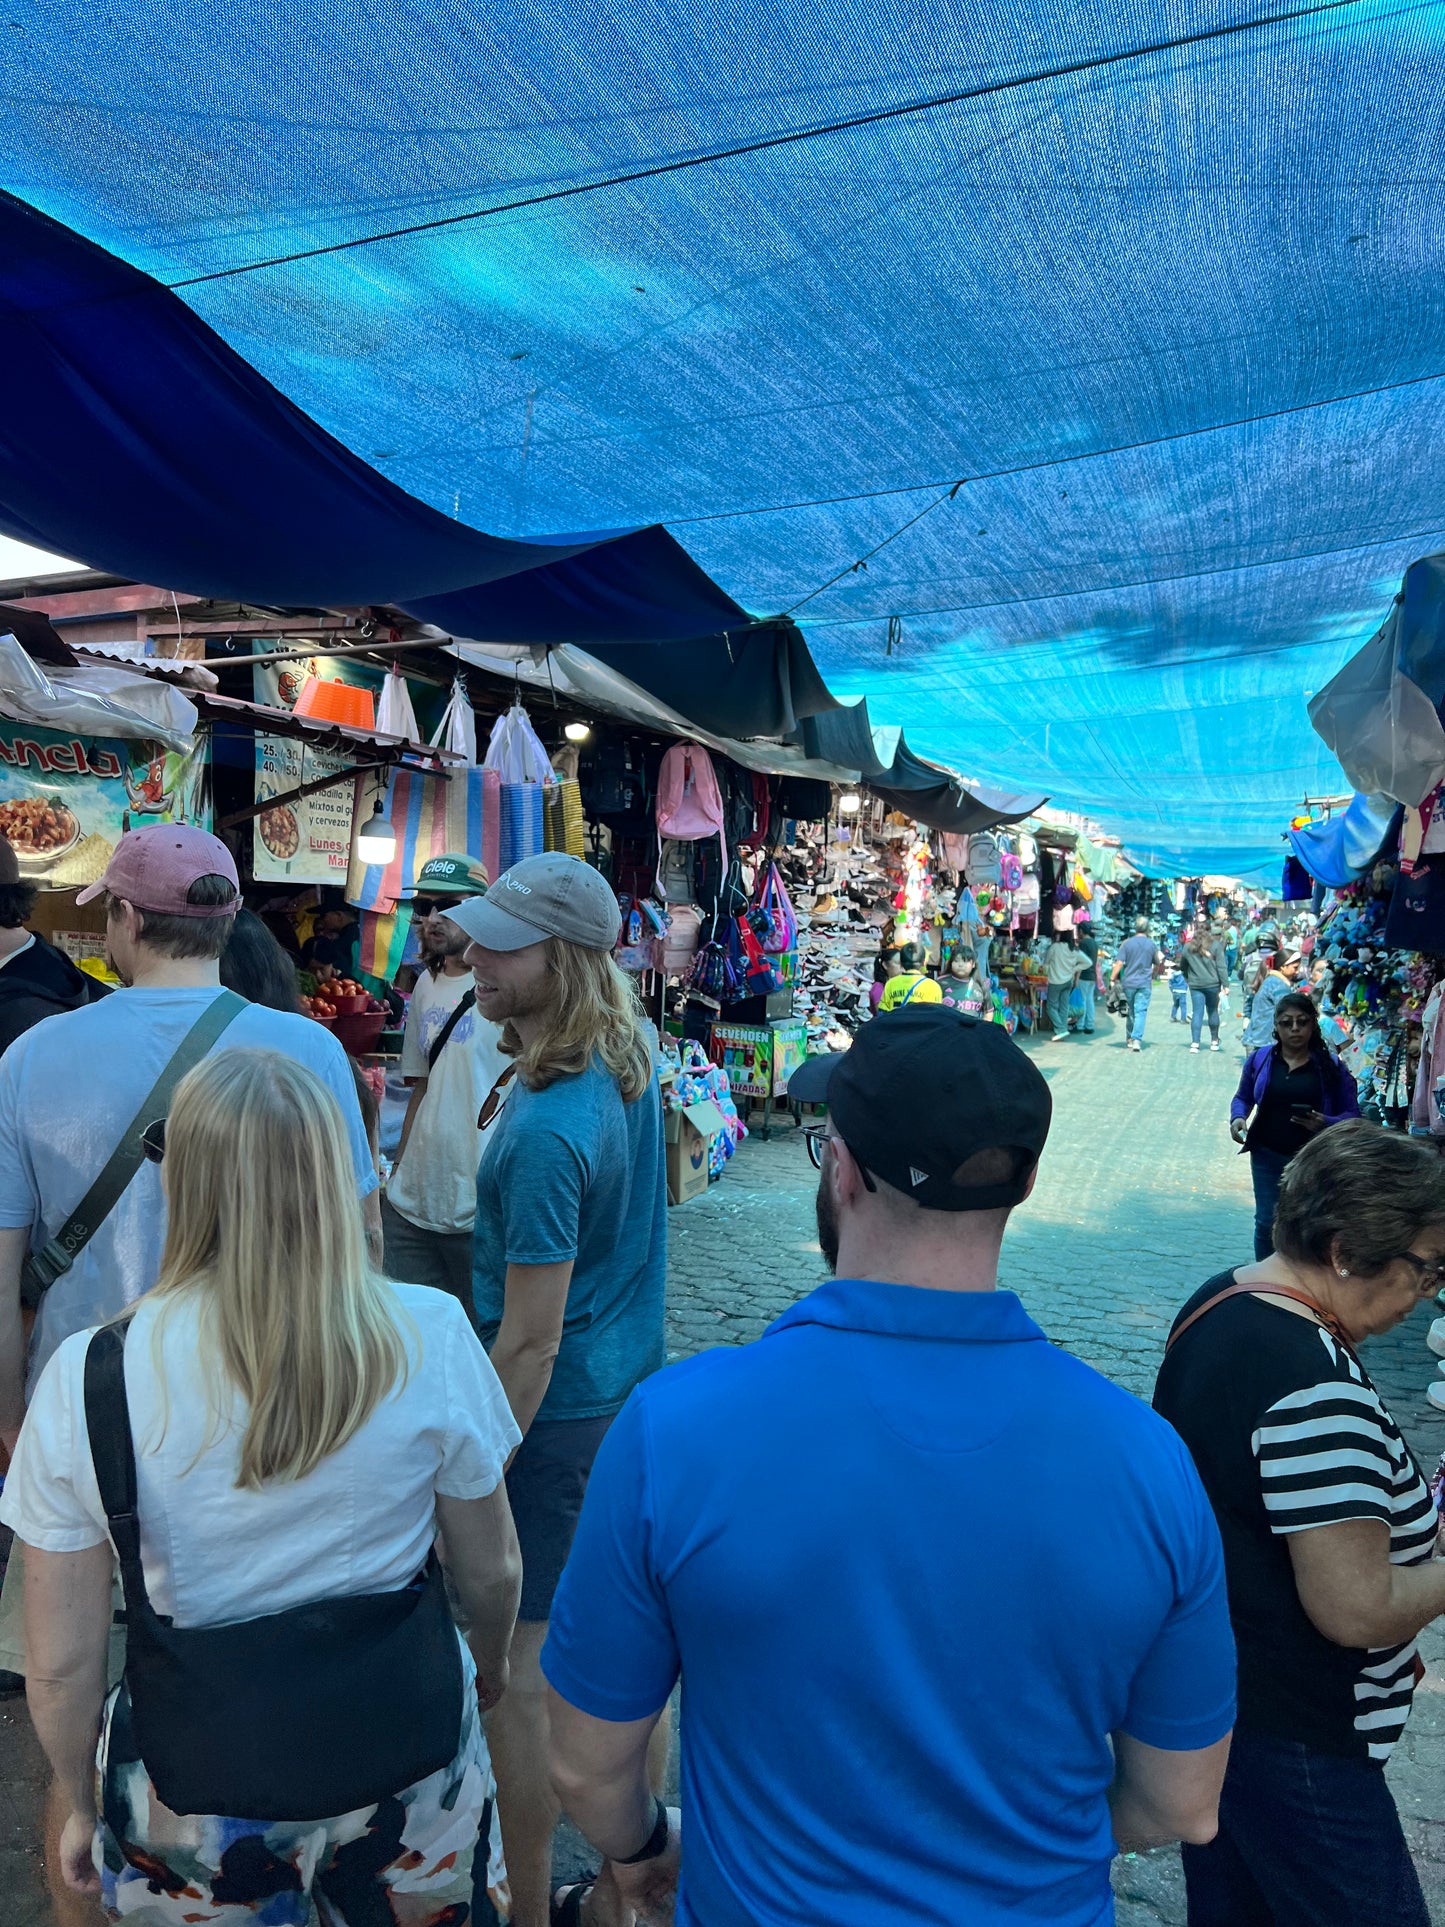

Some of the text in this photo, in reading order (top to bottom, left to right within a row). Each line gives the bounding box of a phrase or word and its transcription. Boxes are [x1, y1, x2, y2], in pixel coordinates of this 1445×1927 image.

[263, 744, 277, 757] 25.
[263, 761, 277, 773] 40.
[286, 765, 300, 777] 50.
[309, 801, 334, 812] Mixtos
[336, 804, 343, 813] al
[308, 816, 350, 828] y cervezas
[309, 835, 342, 851] Lunes
[714, 1027, 769, 1043] SEVENDEN
